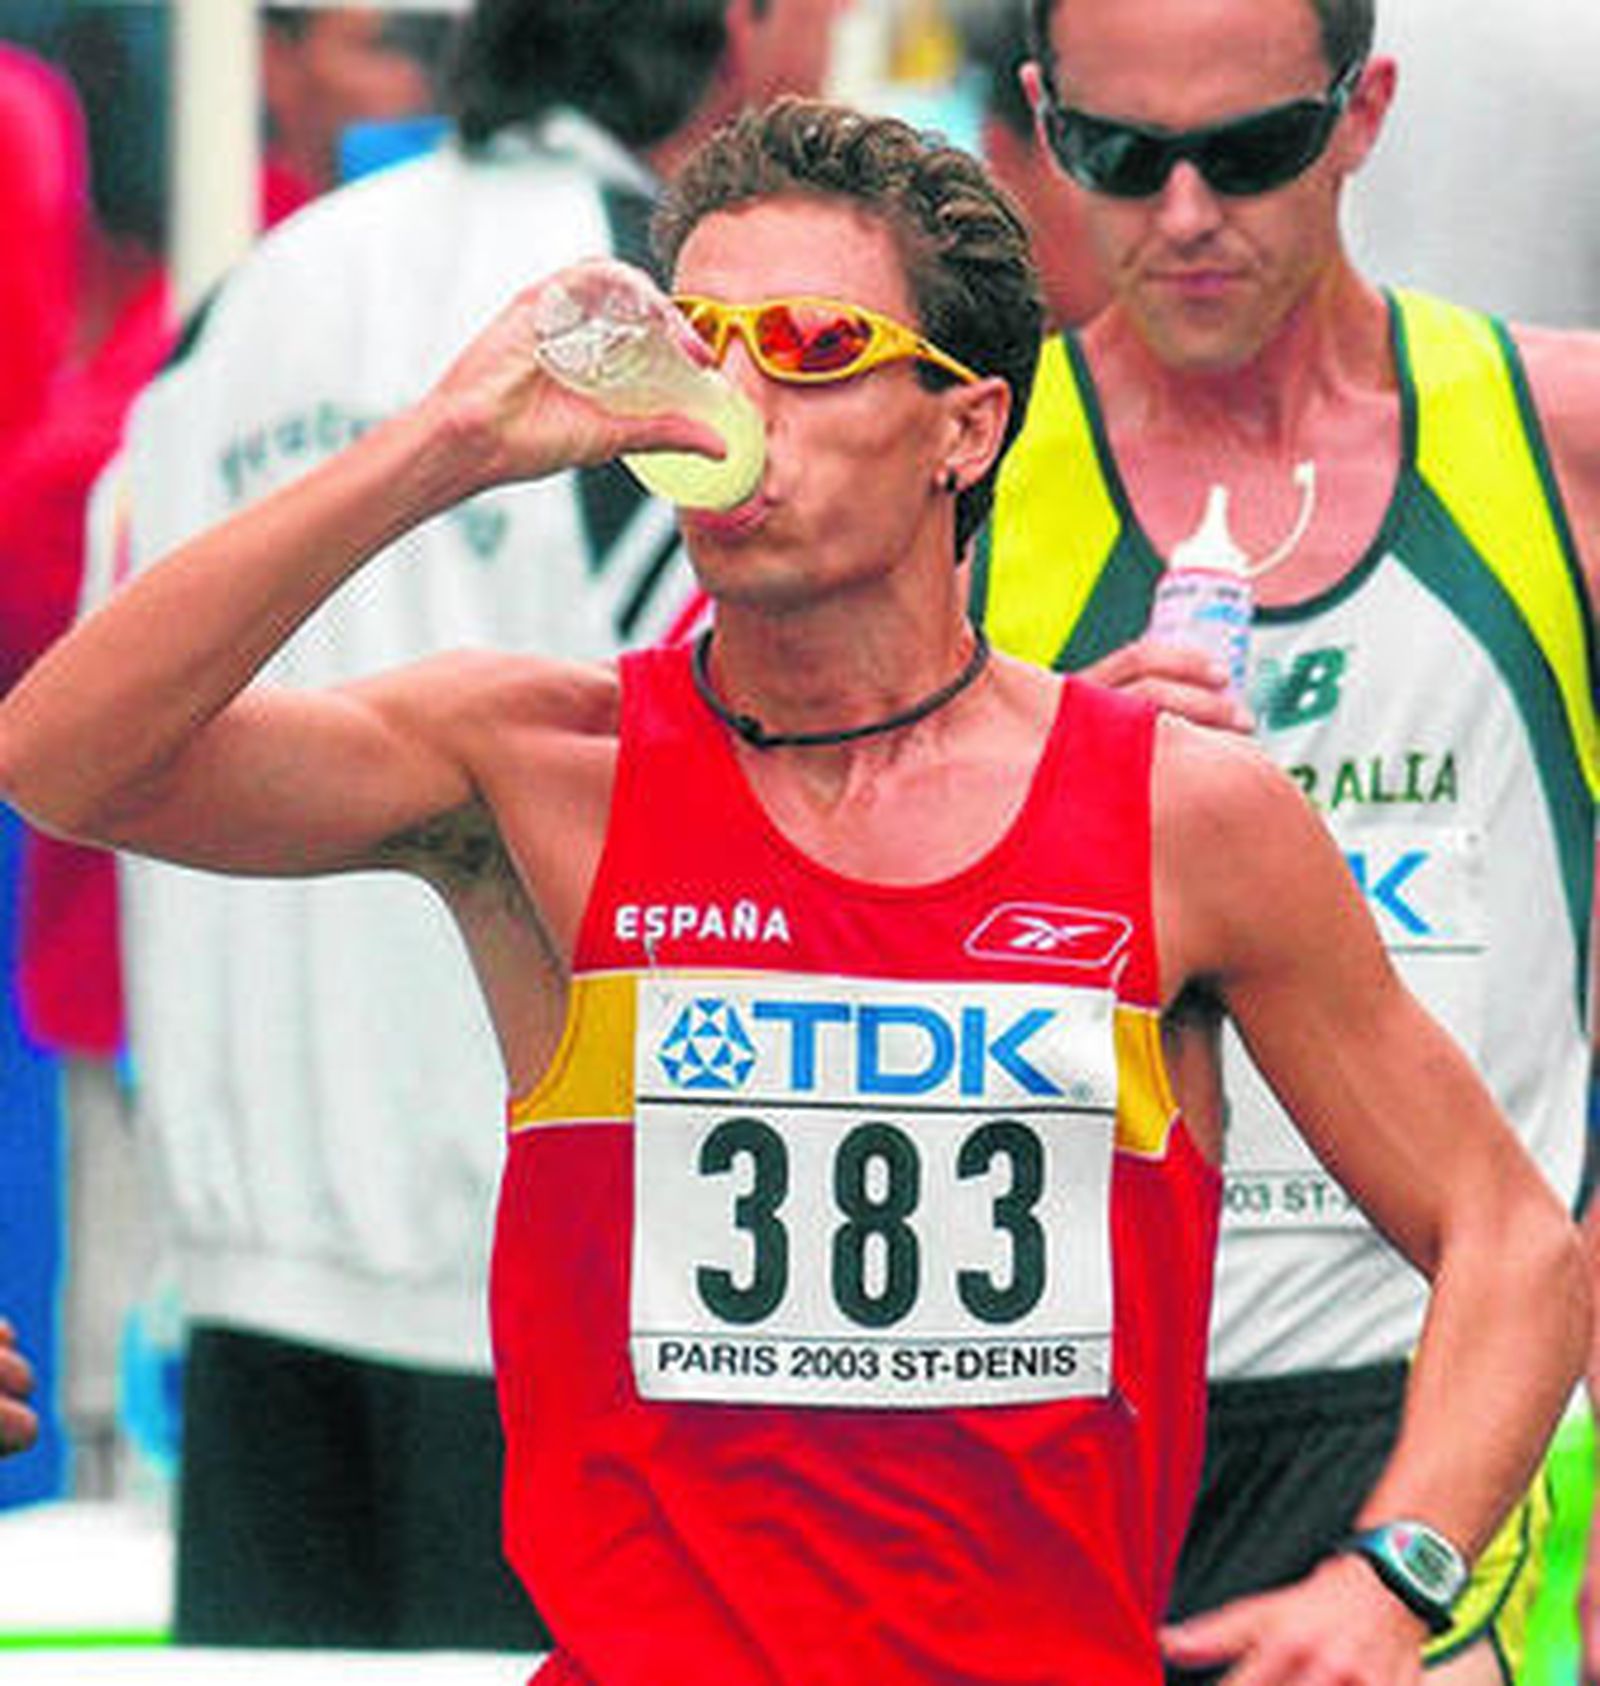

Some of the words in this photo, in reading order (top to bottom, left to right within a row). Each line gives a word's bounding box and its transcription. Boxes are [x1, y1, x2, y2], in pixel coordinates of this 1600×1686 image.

[615, 899, 791, 944] ESPAÑA
[752, 1002, 1064, 1098] TDK
[696, 1117, 1047, 1329] 383
[657, 1341, 778, 1377] PARIS
[790, 1347, 880, 1381] 2003
[891, 1344, 1078, 1381] ST-DENIS
